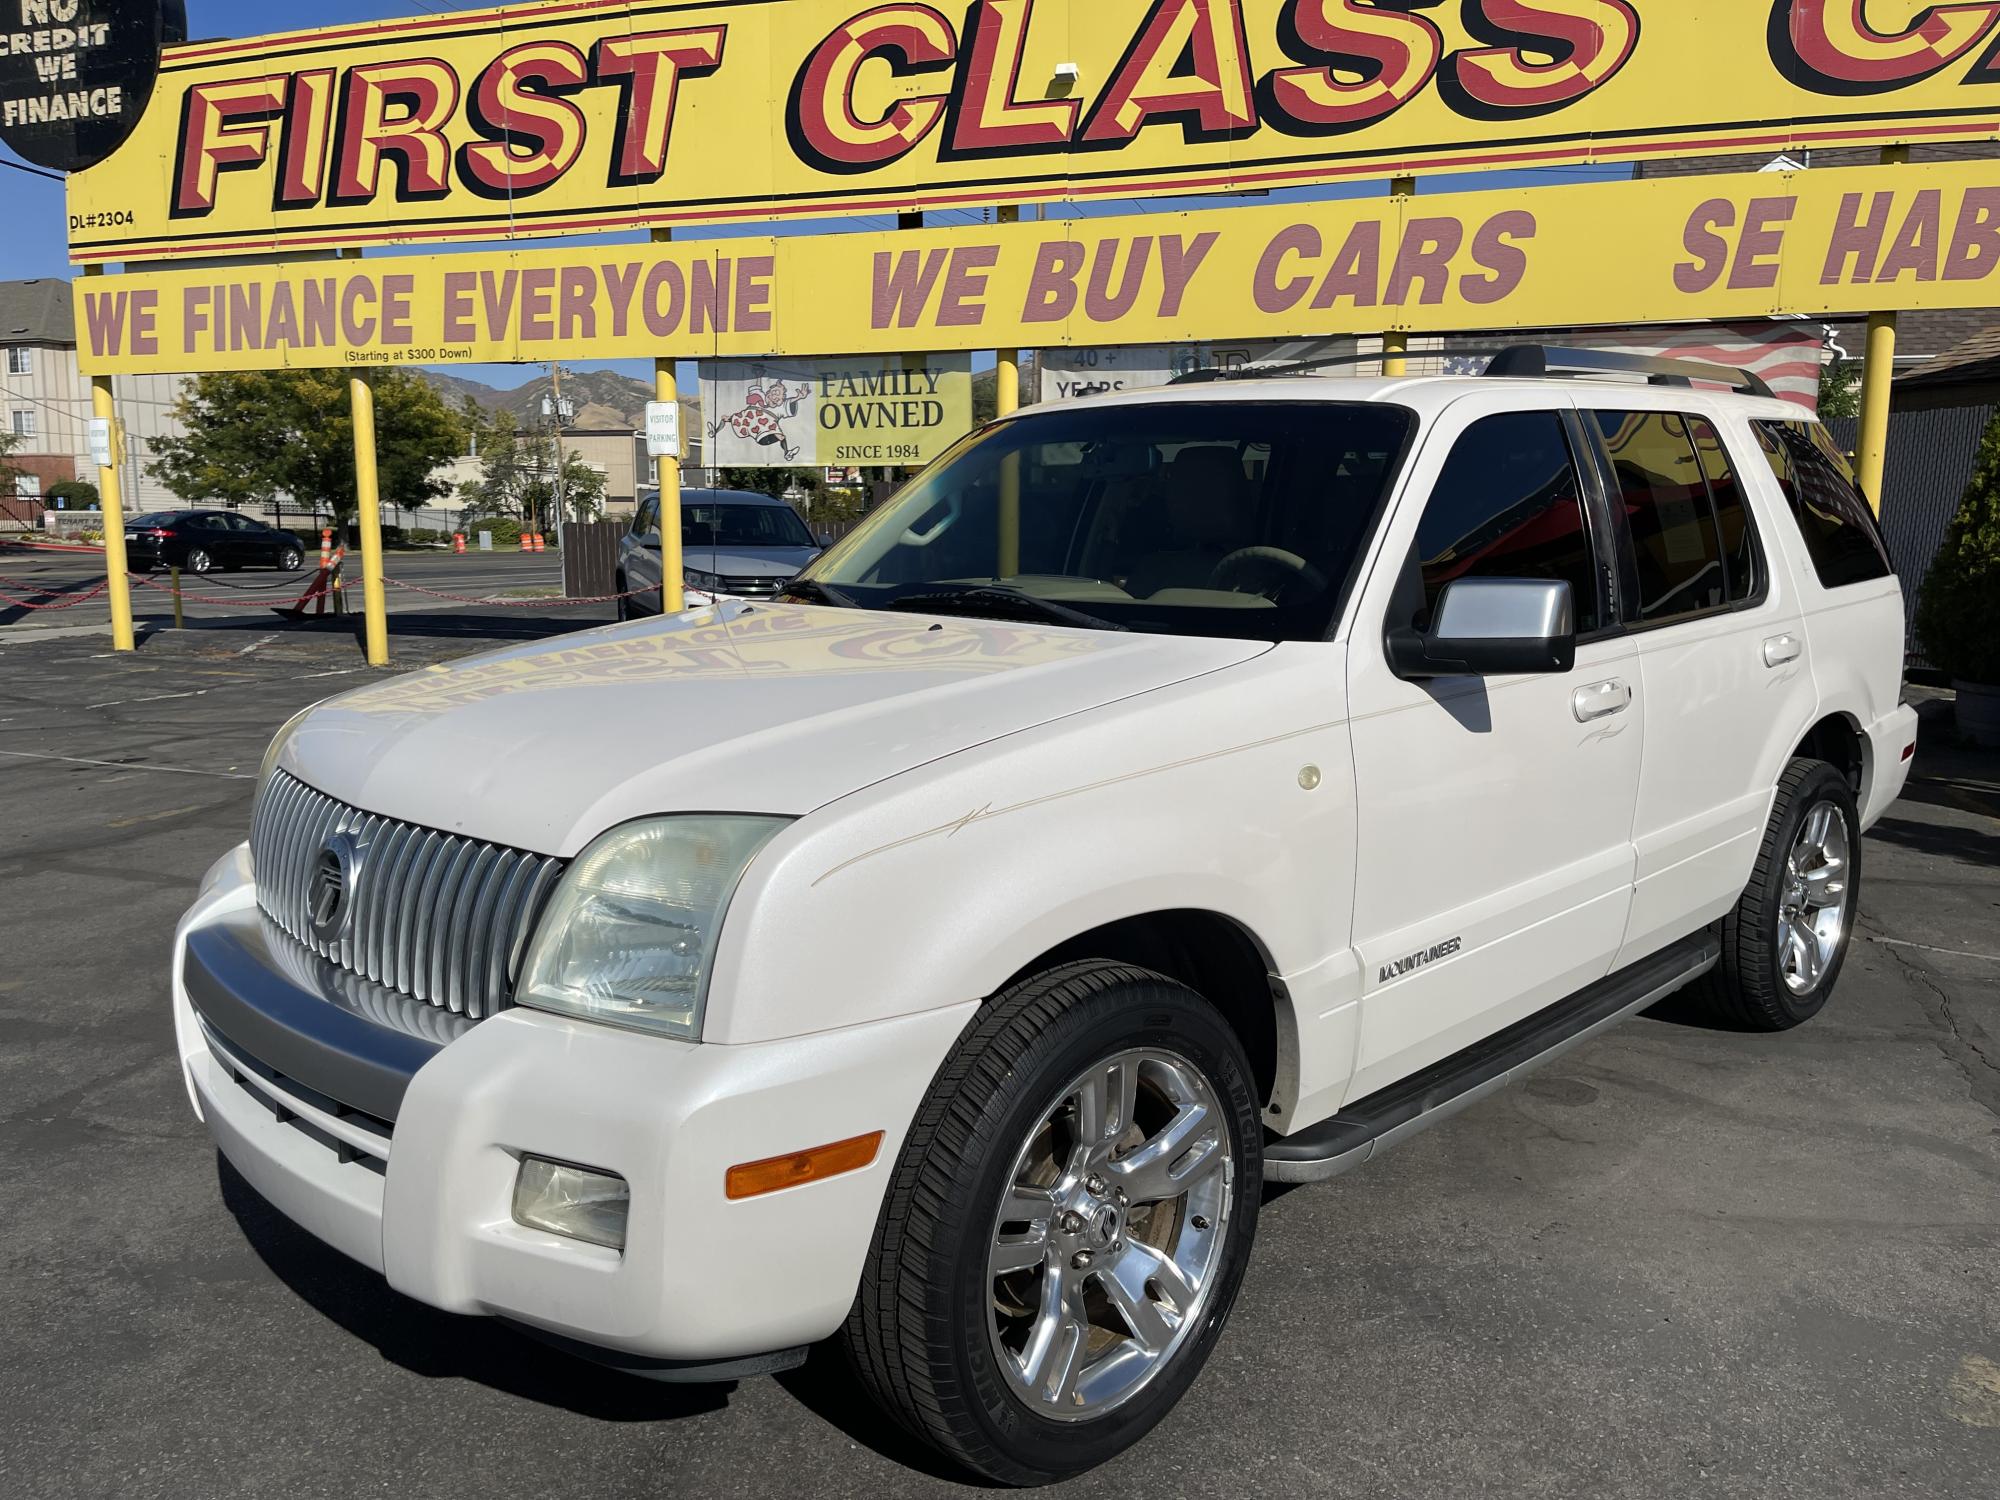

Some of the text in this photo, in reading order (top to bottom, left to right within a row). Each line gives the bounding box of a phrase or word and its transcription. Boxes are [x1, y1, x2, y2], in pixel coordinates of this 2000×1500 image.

[35, 53, 77, 83] WE
[4, 87, 122, 126] FINANCE
[170, 25, 726, 219] FIRST
[785, 0, 1641, 175] CLASS
[70, 210, 134, 229] DL#2304
[1673, 196, 1797, 293] SE
[871, 210, 1536, 329] WE BUY CARS
[85, 256, 776, 356] WE FINANCE EVERYONE
[345, 350, 389, 362] (Starting
[393, 350, 403, 360] at
[440, 346, 472, 359] Down)
[1073, 350, 1098, 367] 40
[818, 367, 943, 398] FAMILY
[819, 400, 944, 430] OWNED
[836, 444, 920, 459] SINCE 1984
[1379, 936, 1462, 984] MOUNTAINEER
